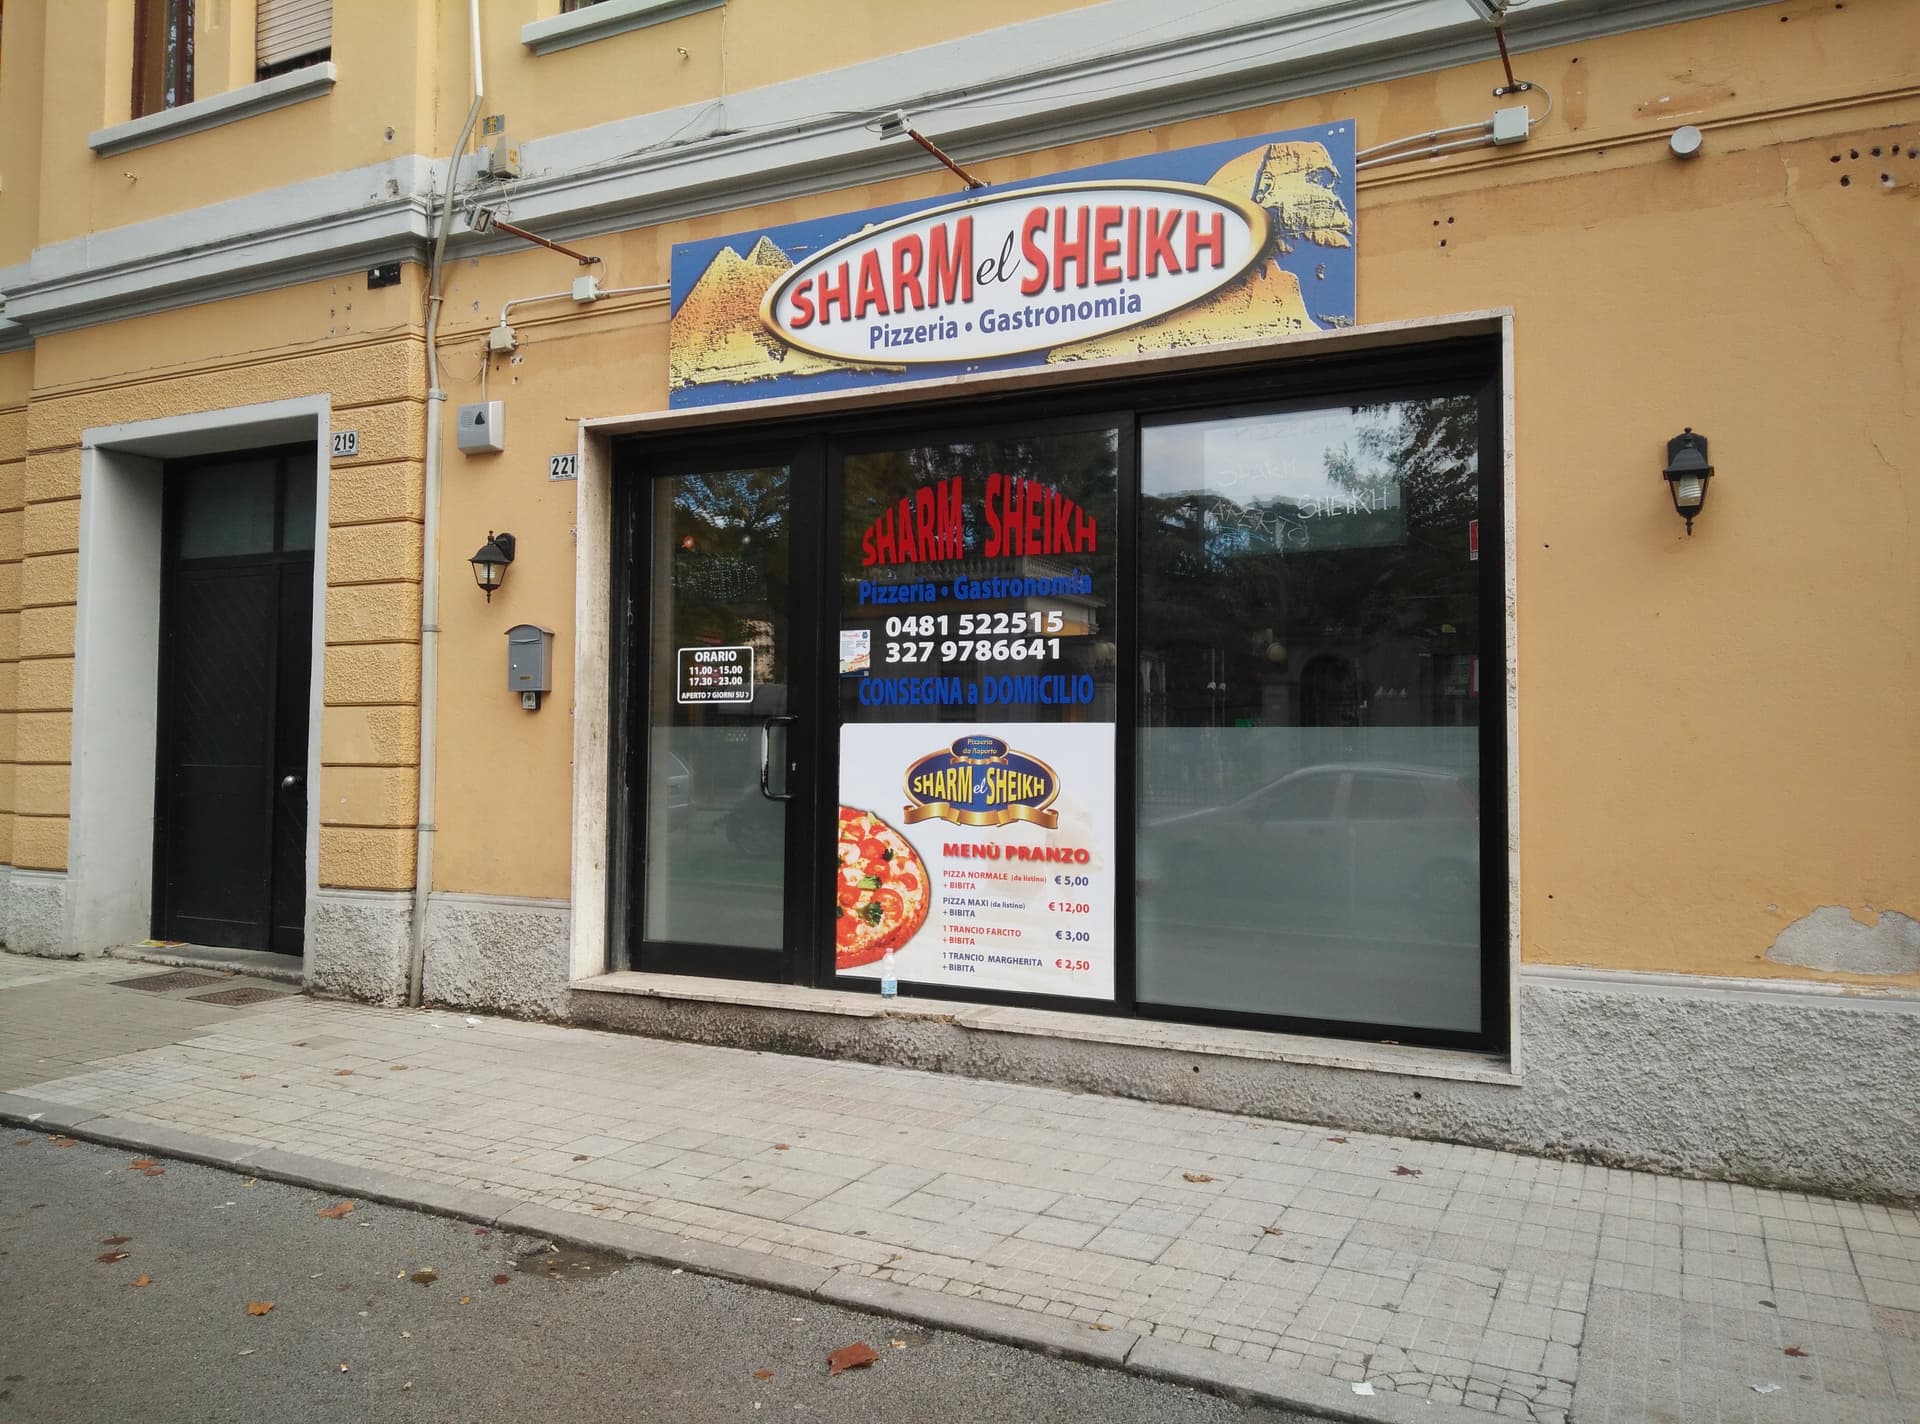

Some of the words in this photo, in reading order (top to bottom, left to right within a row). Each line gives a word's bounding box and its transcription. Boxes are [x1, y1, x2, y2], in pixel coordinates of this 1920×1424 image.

[789, 215, 974, 328] SHARM
[976, 230, 1021, 285] el
[1020, 206, 1226, 296] SHEIKH
[869, 314, 959, 350] Pizzeria
[978, 289, 1142, 334] Gastronomia
[334, 433, 355, 451] 219
[552, 456, 575, 475] 221
[1297, 486, 1388, 519] SHEIKH
[862, 476, 963, 567] SHARM
[984, 473, 1097, 558] SHEIKH
[859, 577, 936, 605] Pizzeria
[953, 569, 1092, 599] Gastronomia
[885, 614, 949, 637] 0481
[958, 611, 1064, 636] 522515
[885, 641, 933, 663] 327
[940, 638, 1060, 663] 9786641
[695, 651, 737, 662] ORARIO
[689, 666, 713, 675] 11.00
[719, 665, 743, 674] 15.00
[689, 677, 712, 686] 17.30
[718, 676, 743, 685] 23.00
[712, 691, 735, 699] GIORNI
[859, 677, 963, 706] CONSEGNA
[967, 684, 978, 703] a
[983, 673, 1095, 705] DOMICILIO
[967, 738, 993, 746] Pizzeria
[913, 765, 973, 803] SHARM
[973, 777, 988, 794] el
[986, 767, 1045, 805] SHEIKH
[943, 842, 1000, 860] MENÙ
[1005, 846, 1090, 864] PRANZO
[943, 870, 966, 878] PIZZA
[967, 871, 1008, 880] NORMALE
[949, 882, 976, 890] BIBITA
[1064, 876, 1089, 887] 5,00
[943, 897, 966, 906] PIZZA
[967, 898, 989, 907] MAXI
[1058, 902, 1090, 913] 12,00
[949, 909, 976, 917] BIBITA
[949, 925, 984, 934] TRANCIO
[986, 928, 1022, 937] FARCITO
[1065, 931, 1090, 942] 3,00
[949, 937, 975, 945] BIBITA
[949, 952, 984, 962] TRANCIO
[987, 955, 1043, 967] MARGHERITA
[1065, 959, 1090, 970] 2,50
[948, 964, 975, 973] BIBITA
